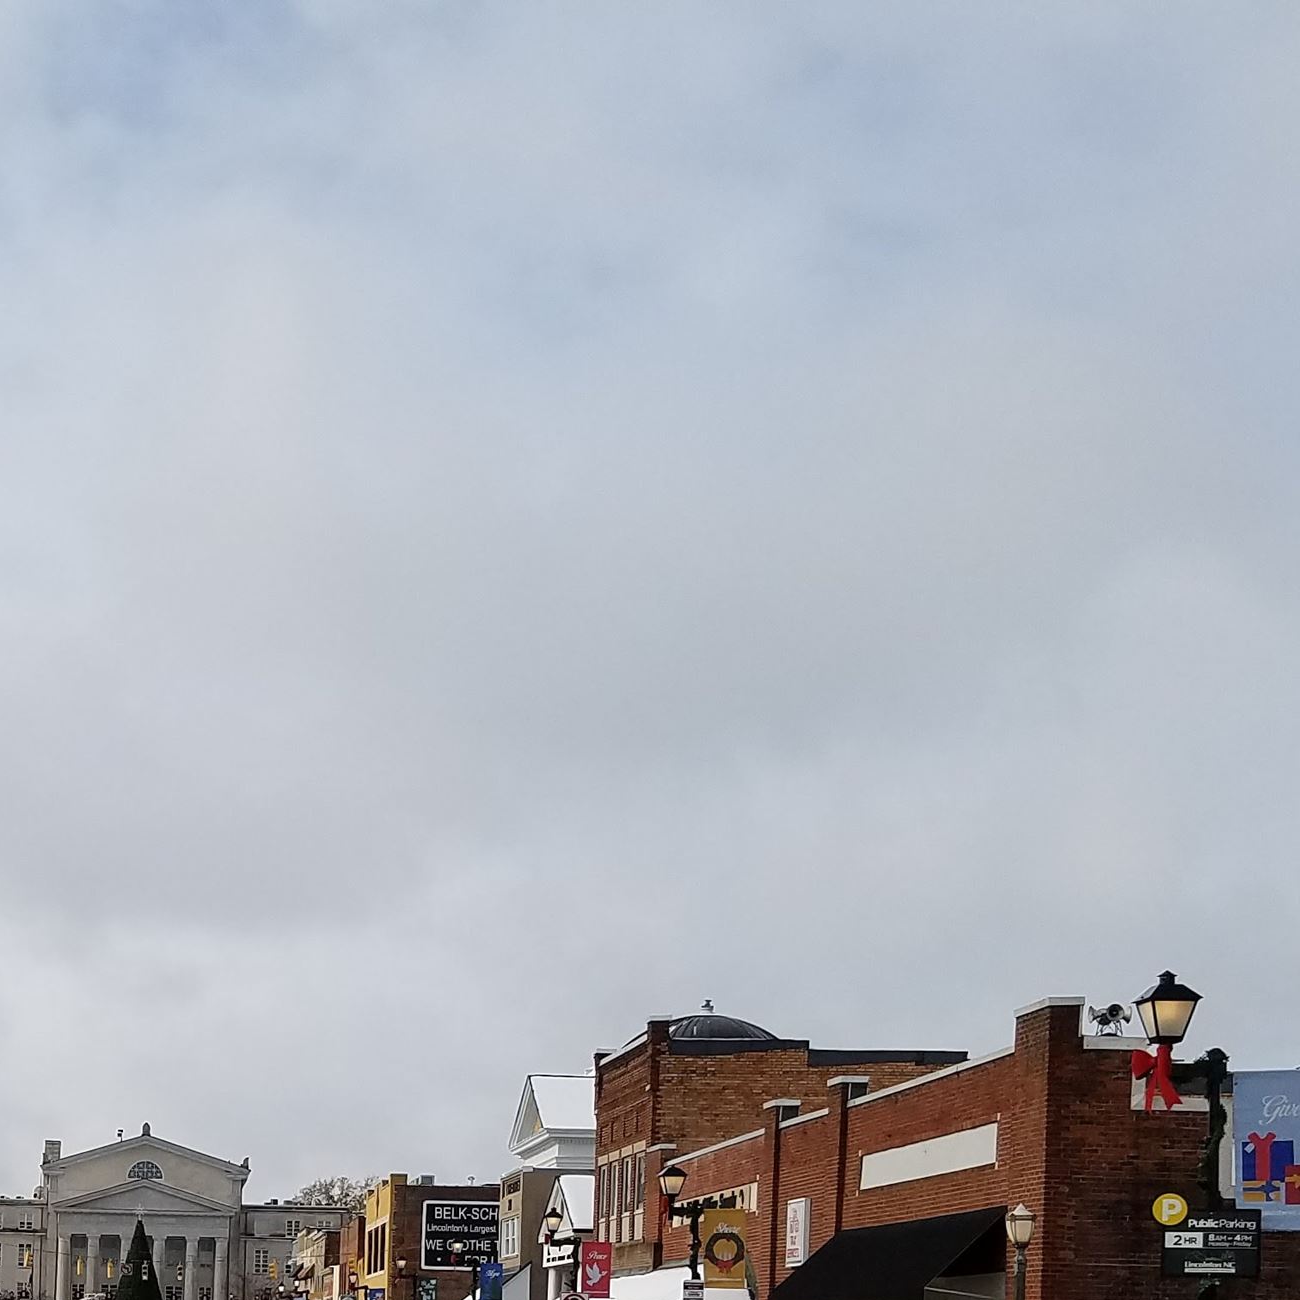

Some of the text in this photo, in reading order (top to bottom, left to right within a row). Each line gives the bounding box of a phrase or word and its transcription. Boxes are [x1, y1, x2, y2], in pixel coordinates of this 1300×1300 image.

[1162, 1198, 1182, 1221] P
[427, 1223, 468, 1234] Lincolnton's
[426, 1239, 444, 1251] WE
[1173, 1235, 1197, 1245] 2 HR
